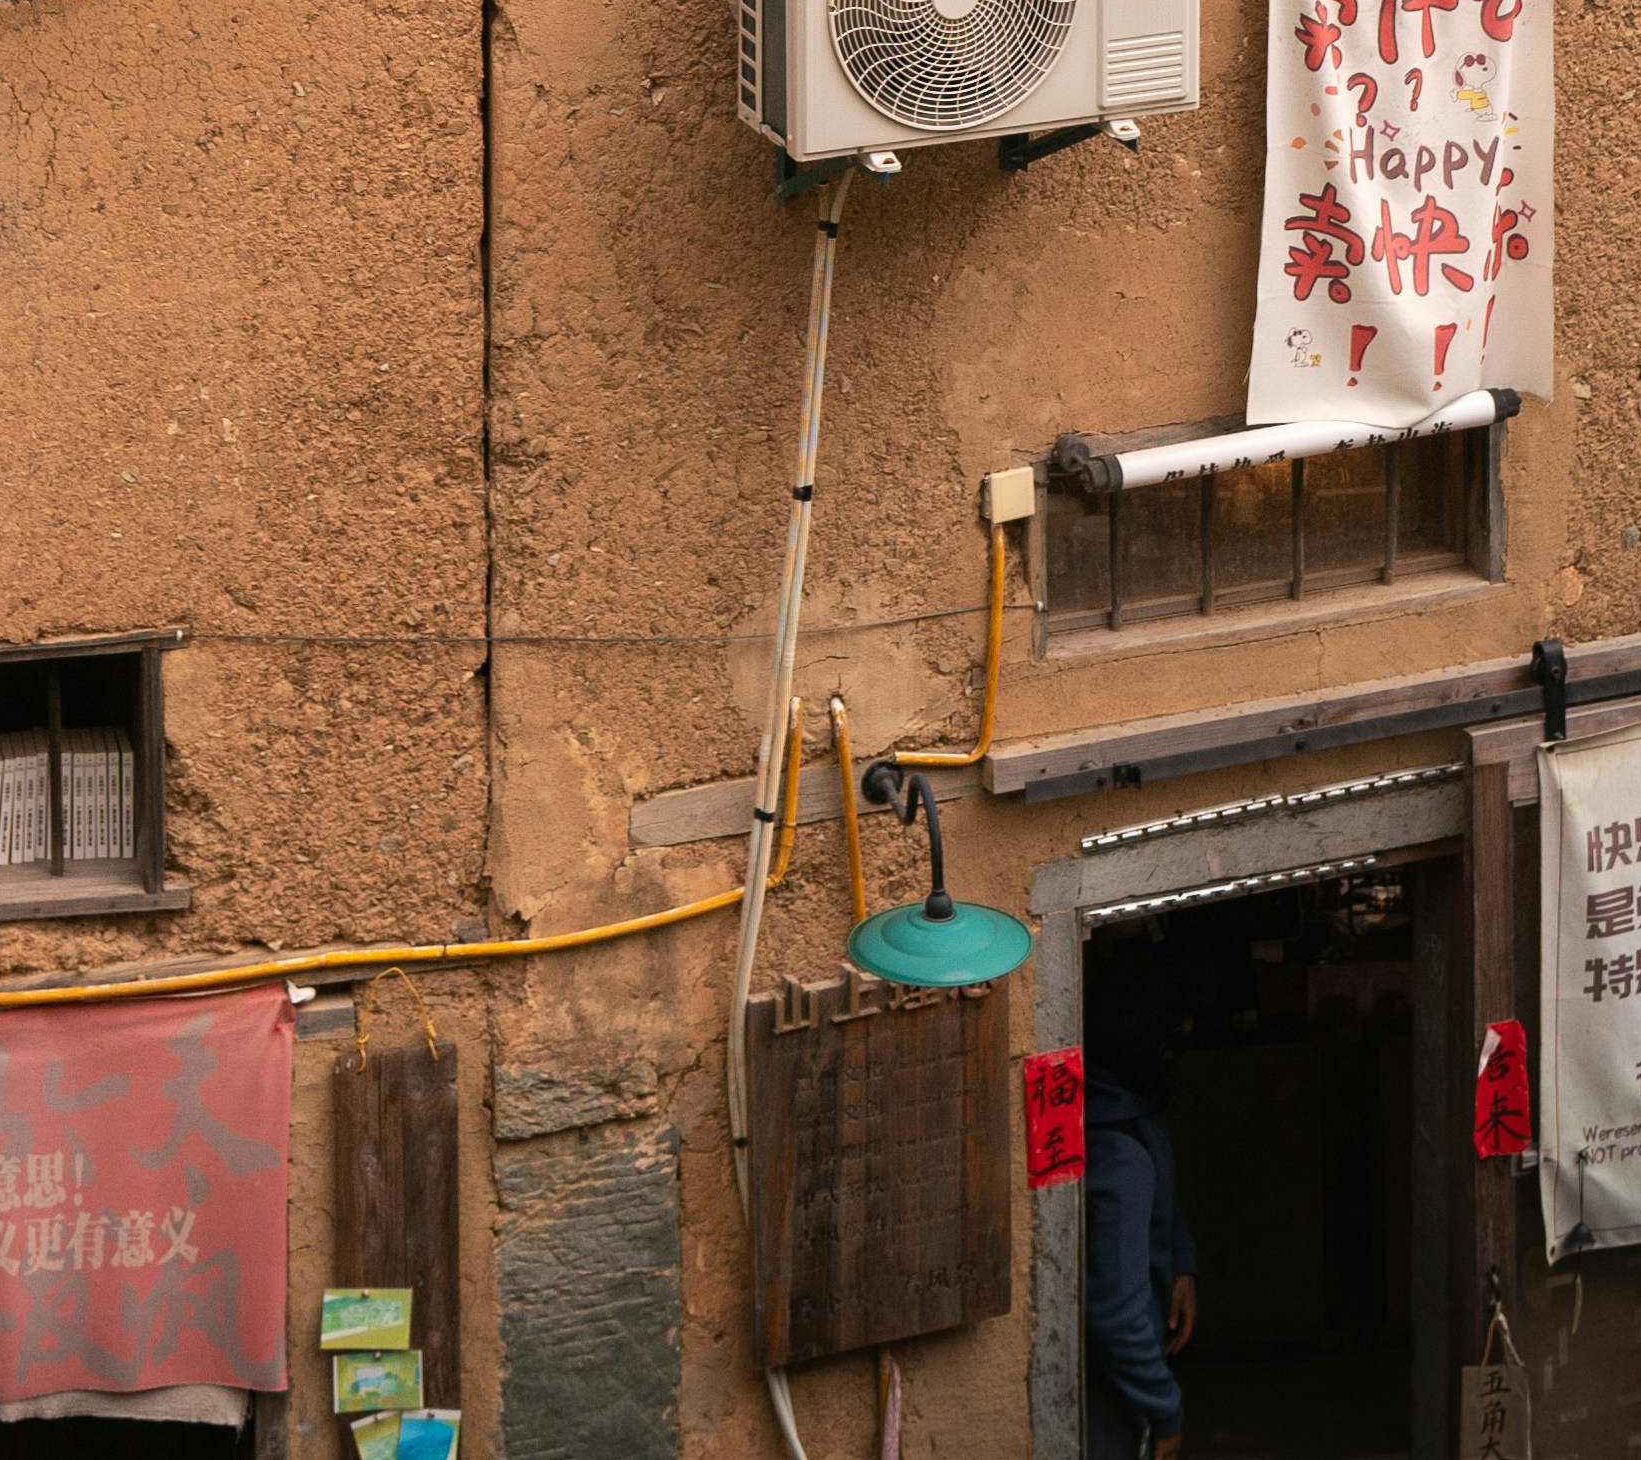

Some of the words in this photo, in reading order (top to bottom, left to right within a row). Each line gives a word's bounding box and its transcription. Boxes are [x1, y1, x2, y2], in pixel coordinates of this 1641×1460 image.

[1349, 125, 1500, 192] Happy
[1283, 168, 1530, 304] 卖快乐
[1030, 1060, 1084, 1178] 福至
[1582, 1143, 1616, 1166] NOT
